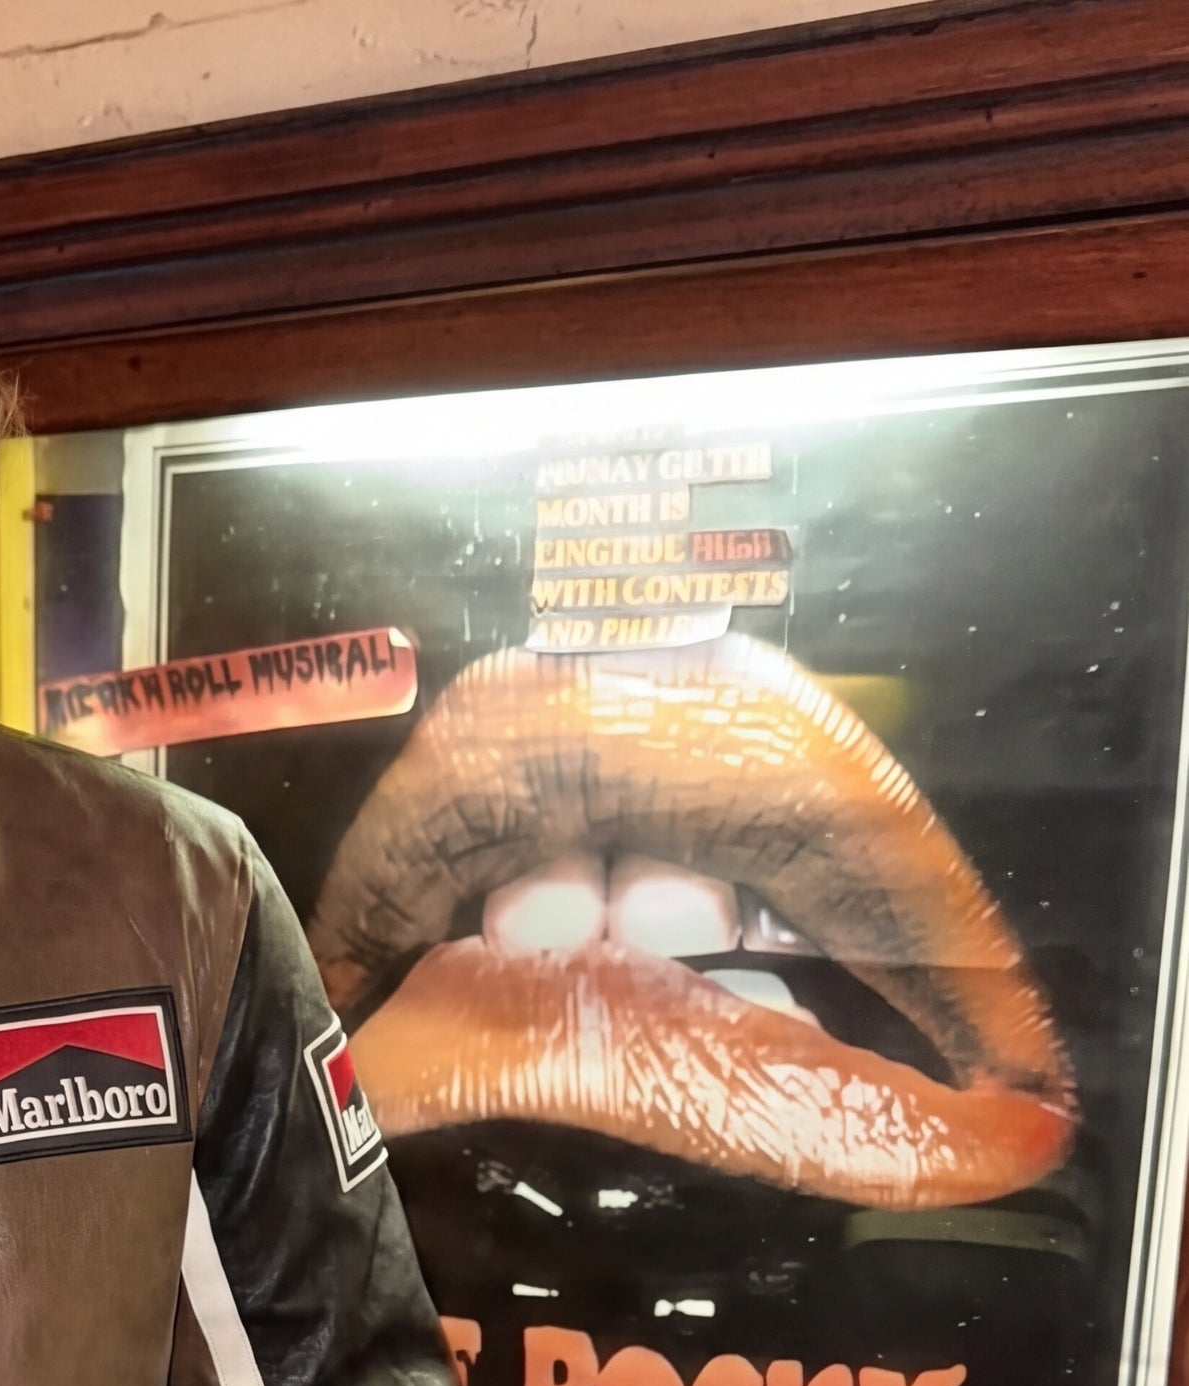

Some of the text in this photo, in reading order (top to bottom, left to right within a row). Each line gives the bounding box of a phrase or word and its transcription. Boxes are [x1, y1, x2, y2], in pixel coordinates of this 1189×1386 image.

[536, 488, 689, 530] MONTH IS
[532, 577, 616, 608] WITH
[532, 617, 595, 648] AND
